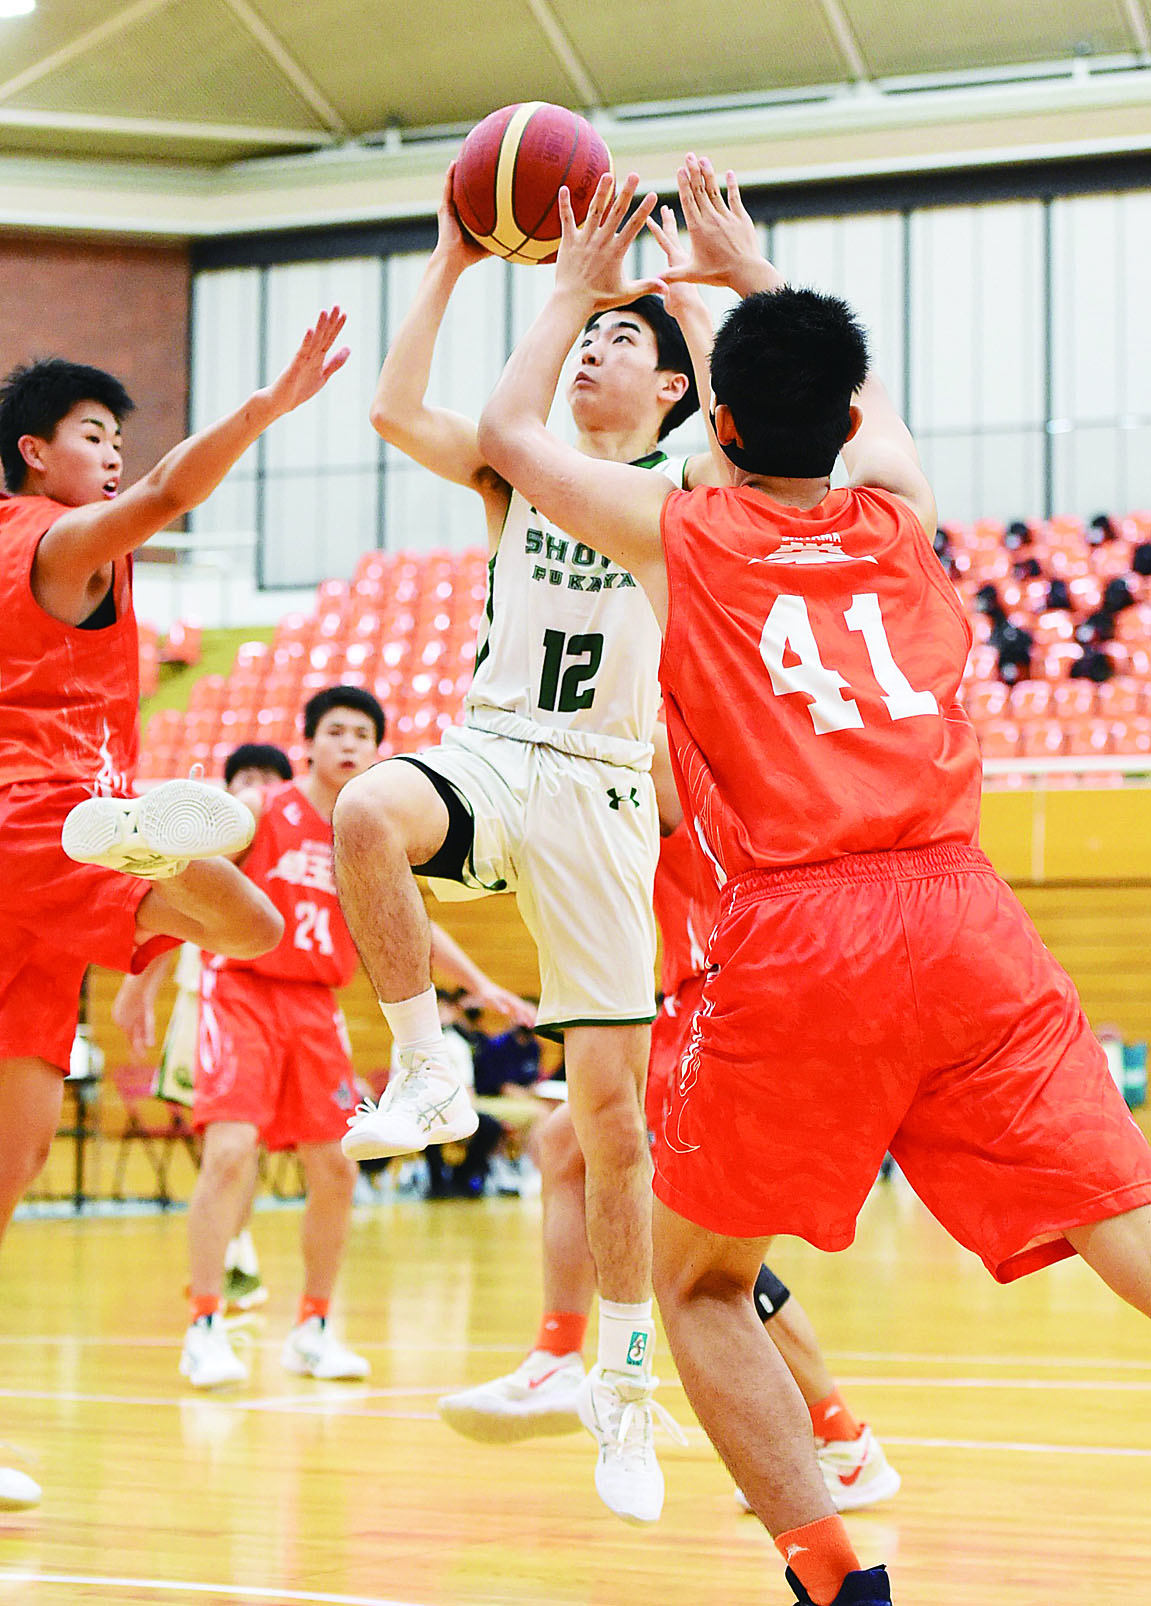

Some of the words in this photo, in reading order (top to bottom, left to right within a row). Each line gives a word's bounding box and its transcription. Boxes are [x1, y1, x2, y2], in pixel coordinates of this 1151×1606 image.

[532, 564, 636, 592] FUKAYA
[538, 629, 604, 712] 12
[759, 592, 939, 735] 41
[294, 901, 334, 955] 24
